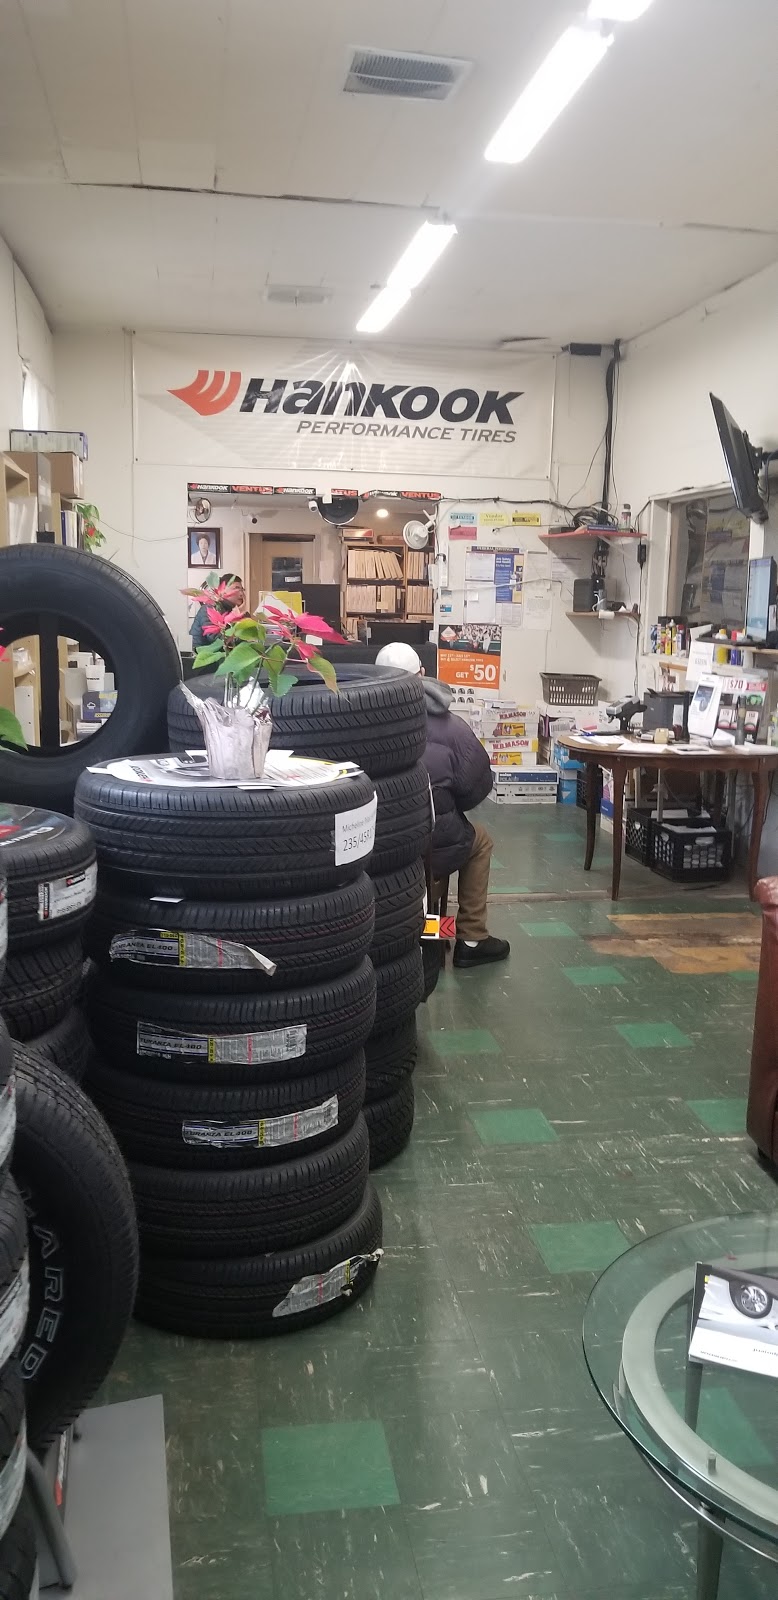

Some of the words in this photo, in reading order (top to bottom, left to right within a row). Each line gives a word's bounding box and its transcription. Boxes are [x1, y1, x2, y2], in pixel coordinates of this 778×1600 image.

[296, 419, 454, 440] PERFORMANCE
[460, 427, 517, 443] TIRES
[401, 491, 440, 499] VENTUS
